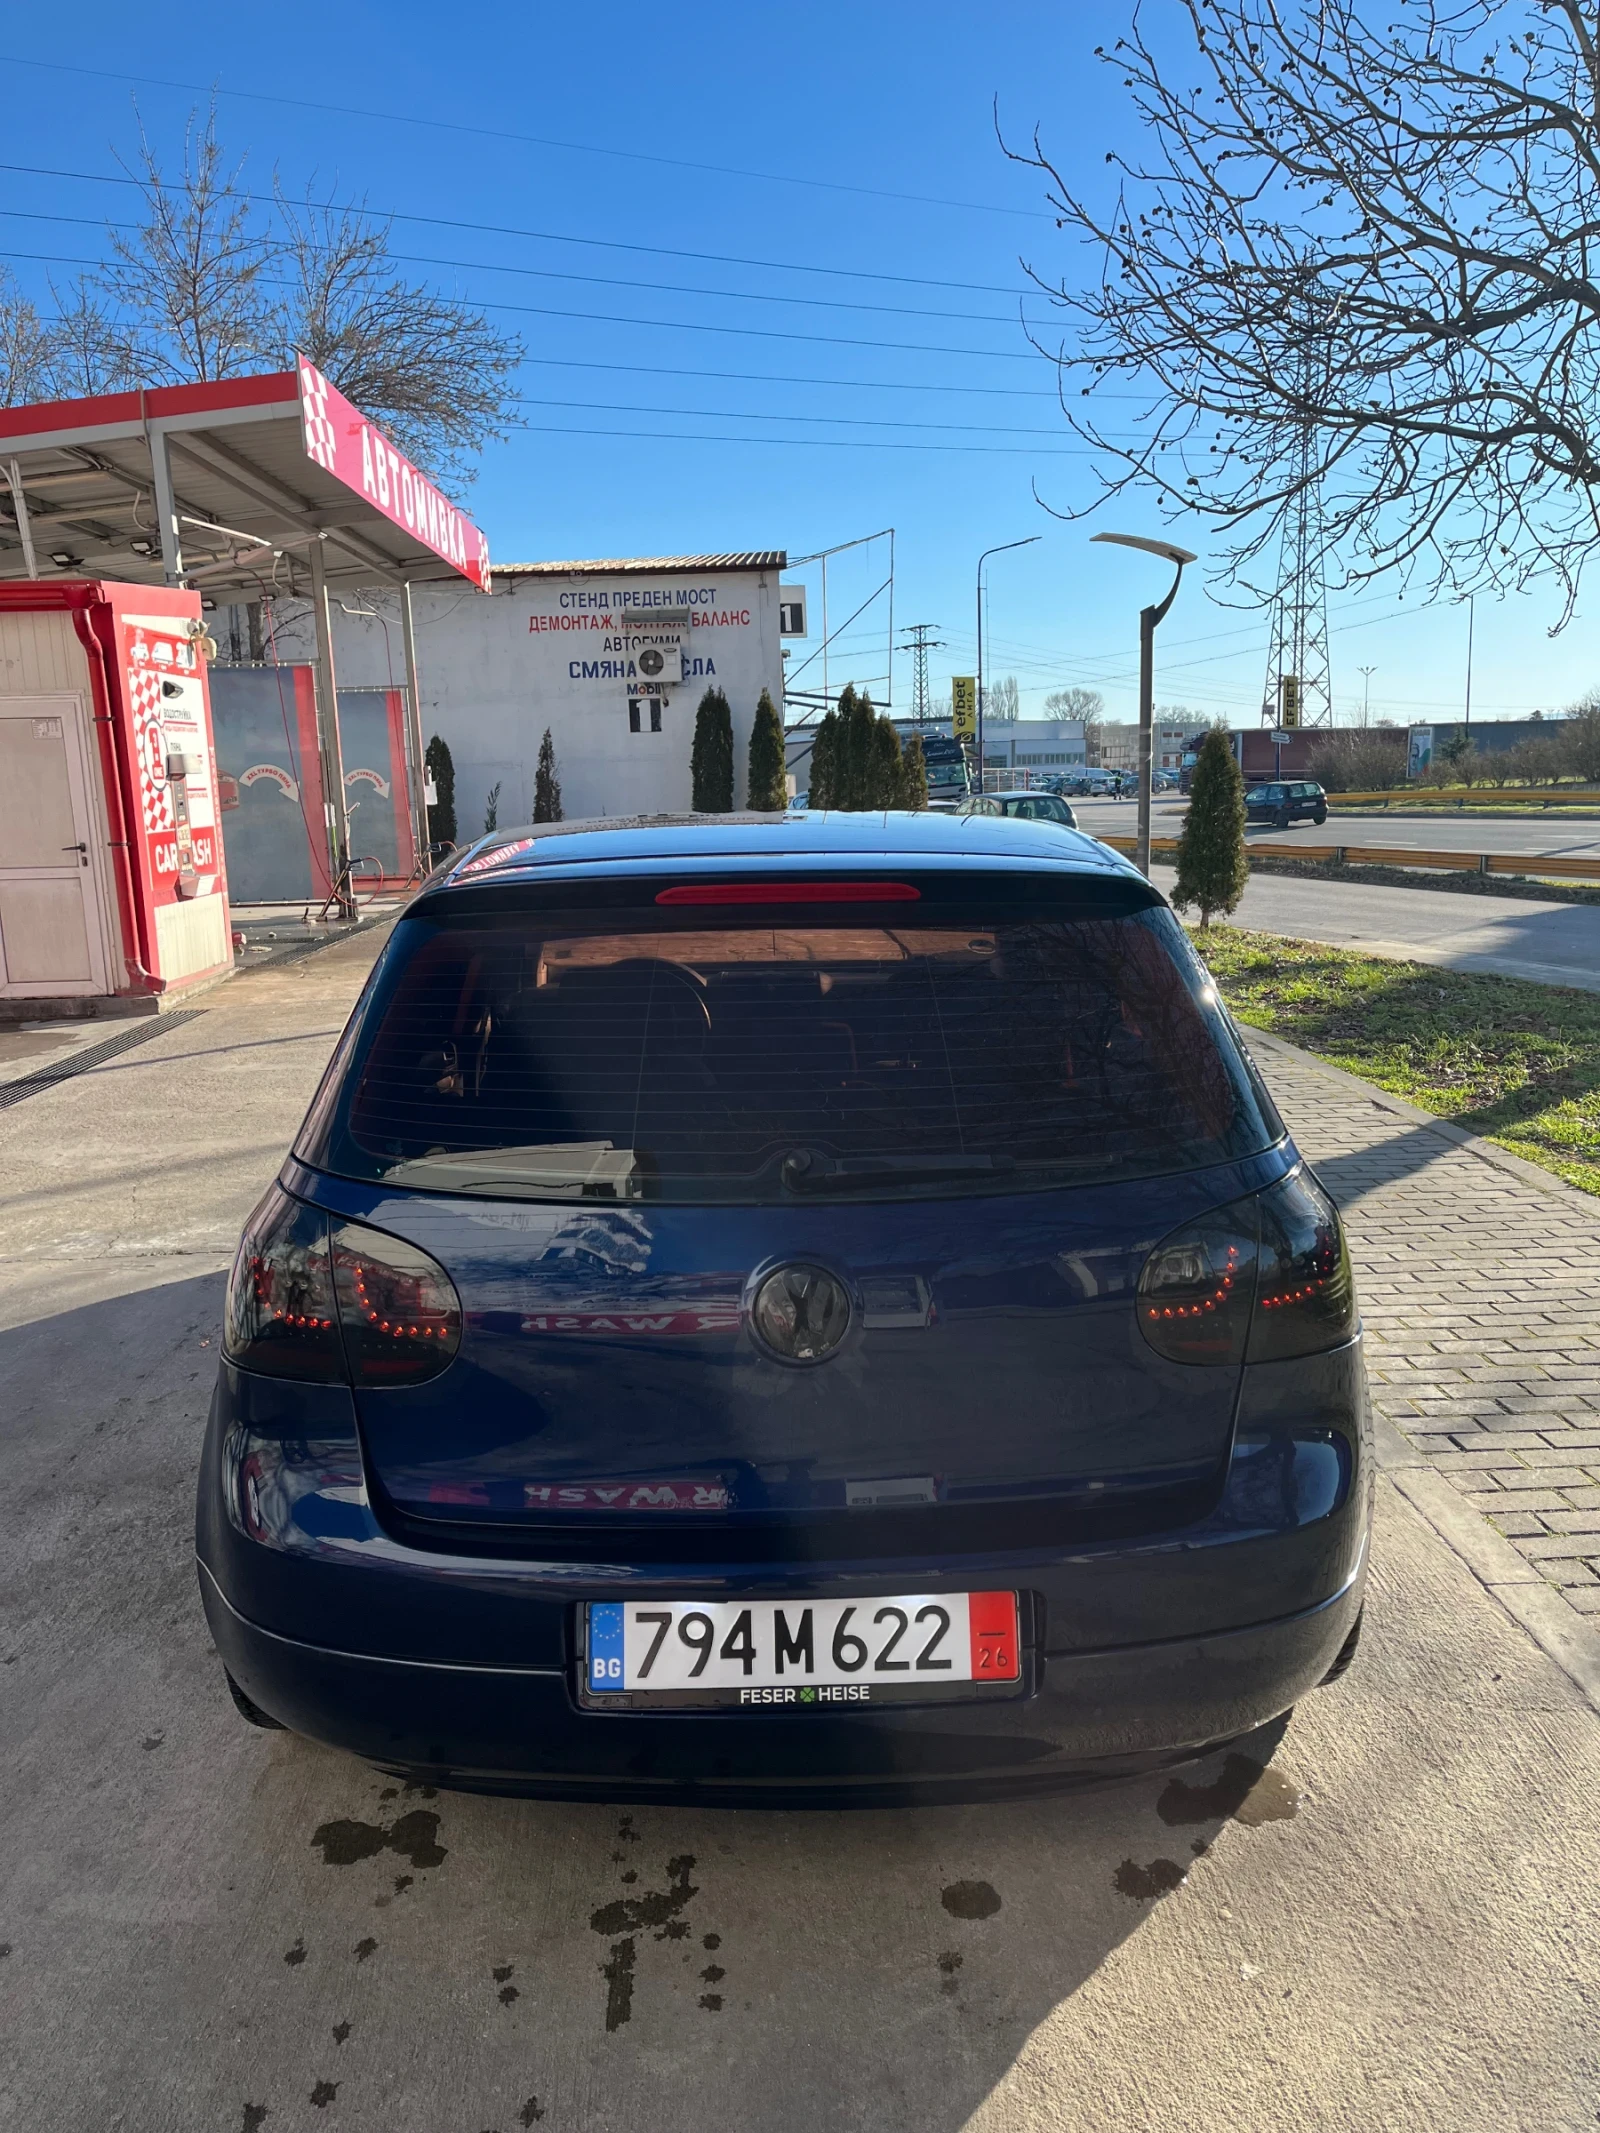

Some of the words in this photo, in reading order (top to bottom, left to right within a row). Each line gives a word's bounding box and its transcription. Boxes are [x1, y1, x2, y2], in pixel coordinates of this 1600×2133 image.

[362, 425, 467, 569] АВТОМИВКА
[560, 592, 609, 610] СТЕНД
[613, 590, 672, 608] ПРЕДЕН
[676, 588, 717, 605] МОСТ
[529, 614, 618, 633] ДЕМОНТАЖ,
[691, 610, 750, 627] БАЛАНС
[569, 660, 637, 679] СМЯНА
[627, 683, 661, 696] Mobil
[955, 681, 966, 727] efbet
[1286, 679, 1295, 726] EFBET
[635, 699, 652, 732] 1
[246, 770, 258, 781] XXL
[257, 767, 277, 776] ТУРБО
[277, 772, 291, 789] ПЯНА
[155, 842, 179, 873] CAR
[635, 1609, 757, 1679] 794
[773, 1608, 814, 1674] M
[831, 1605, 952, 1674] 622
[593, 1657, 622, 1679] BG
[978, 1647, 1008, 1669] 26
[740, 1688, 796, 1704] FESER
[817, 1685, 871, 1702] HEISE
